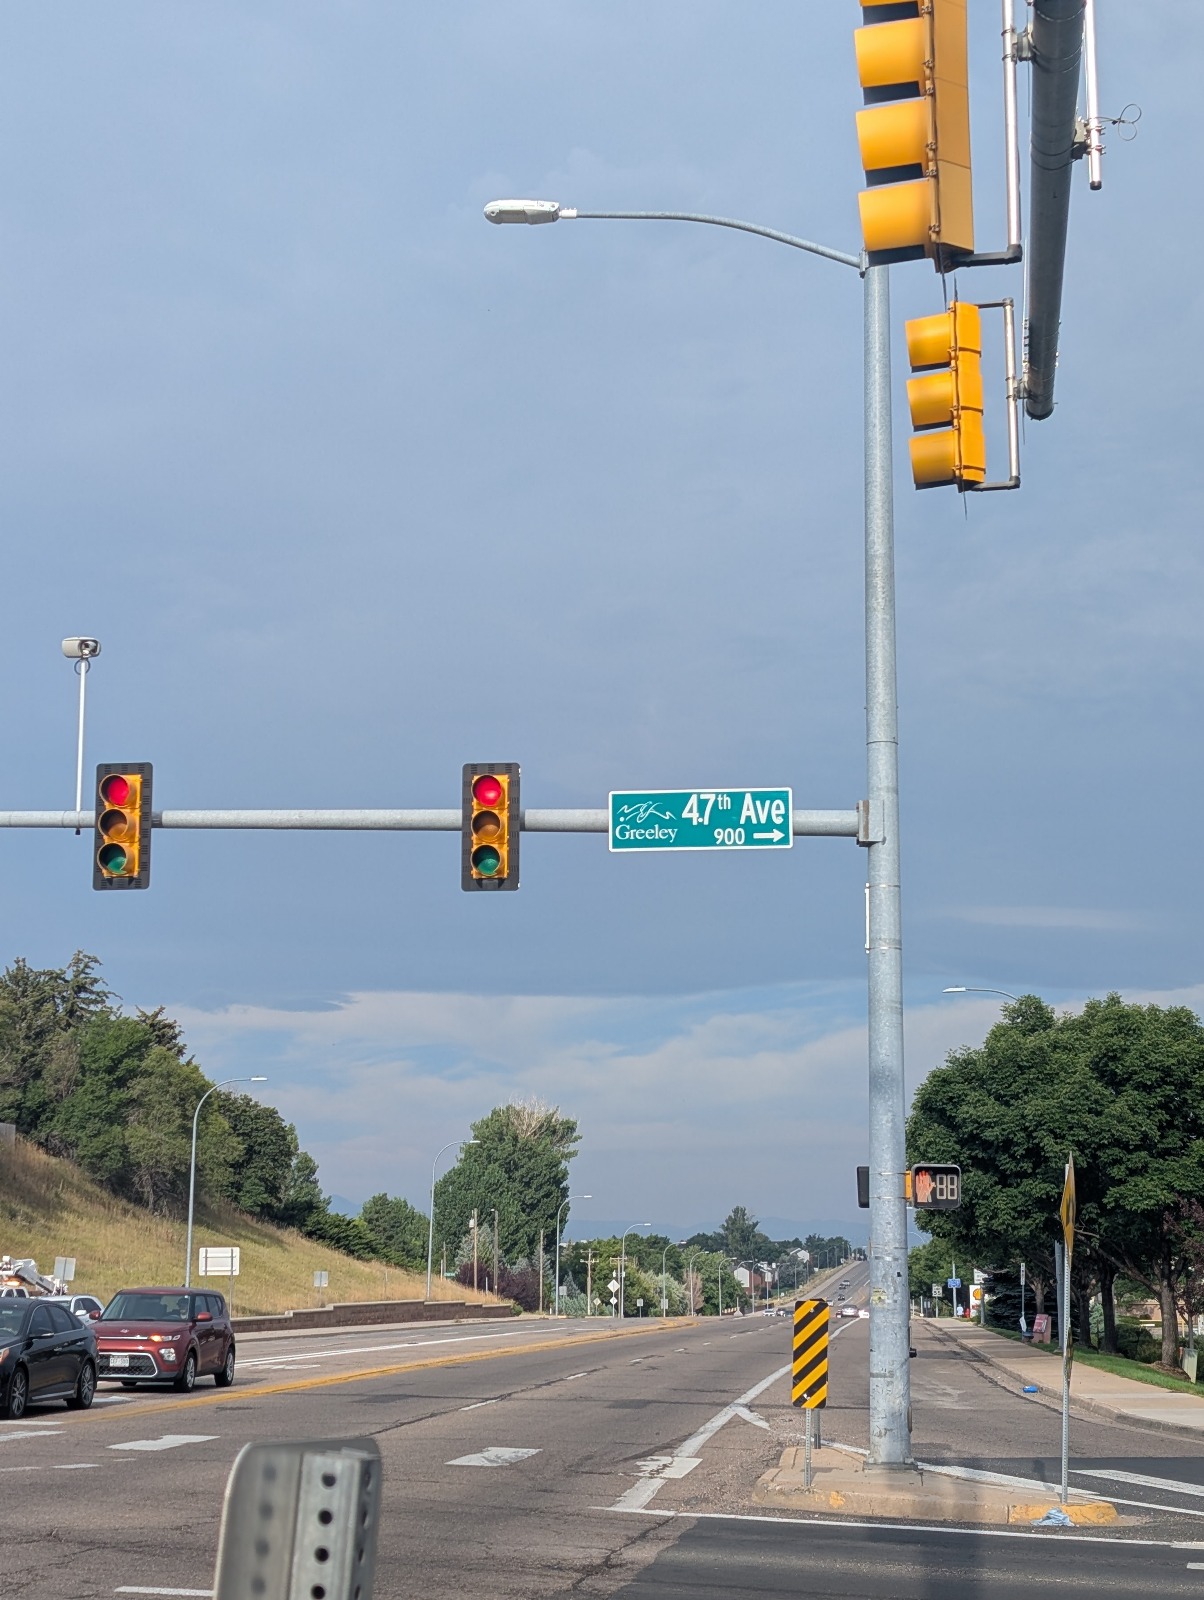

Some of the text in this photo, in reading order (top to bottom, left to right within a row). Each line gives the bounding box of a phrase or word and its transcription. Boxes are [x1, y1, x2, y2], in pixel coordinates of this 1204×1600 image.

[681, 792, 786, 826] 47th Ave
[615, 824, 678, 843] Greeley
[714, 827, 745, 845] 900
